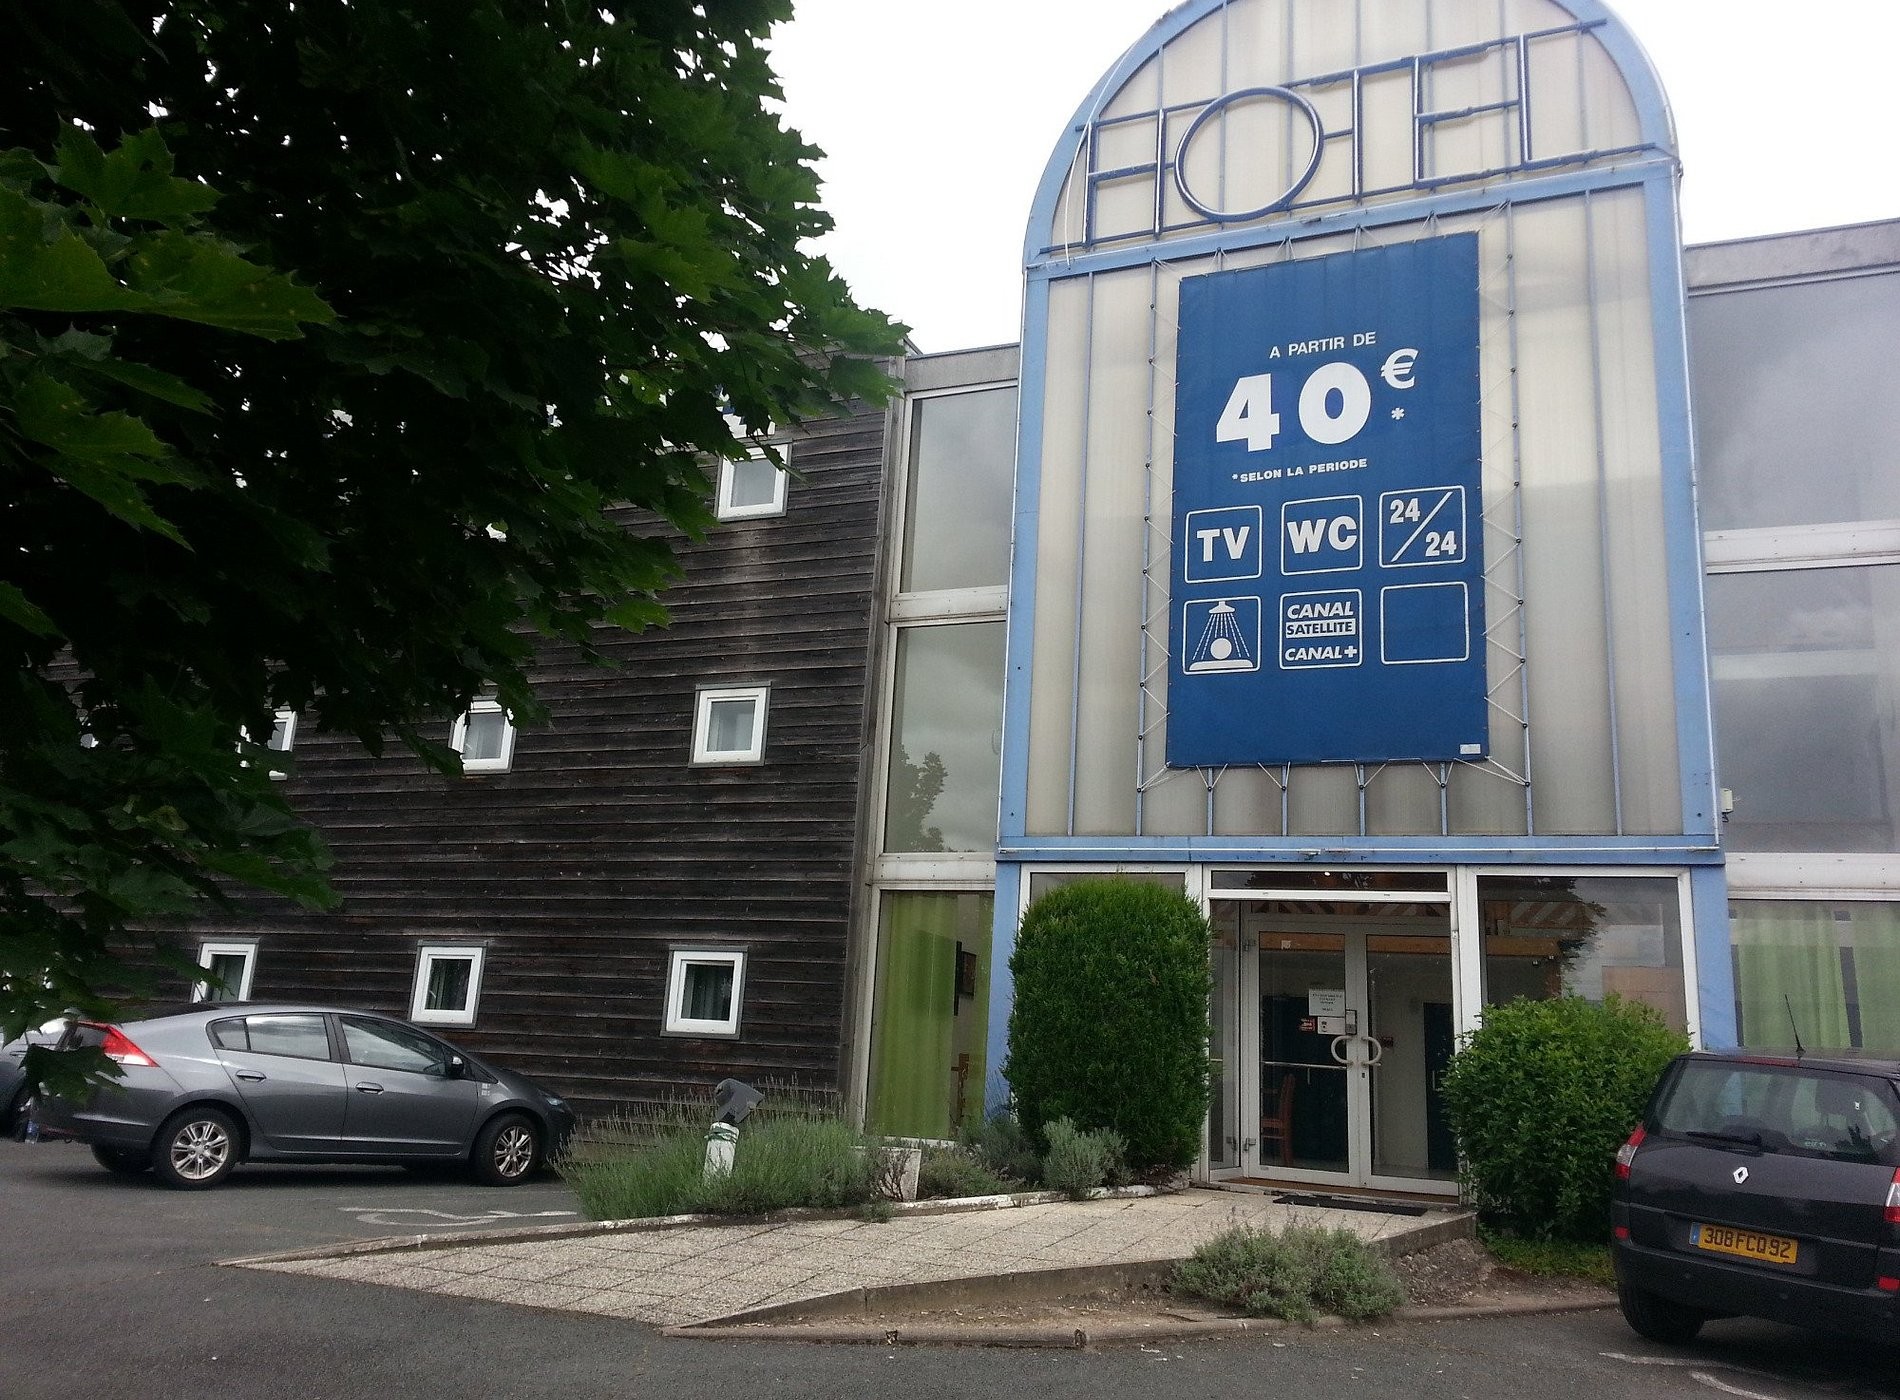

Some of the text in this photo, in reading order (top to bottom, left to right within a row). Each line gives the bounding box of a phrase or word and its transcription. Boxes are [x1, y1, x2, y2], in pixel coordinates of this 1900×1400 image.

[1083, 32, 1655, 246] HOTEL
[1269, 331, 1376, 359] A PARTIR DE
[1287, 466, 1304, 476] LA
[1308, 458, 1368, 474] PERIODE
[1197, 526, 1250, 562] TV
[1287, 515, 1358, 554] WC
[1287, 601, 1354, 619] CANAL
[1286, 621, 1353, 635] SATELLITE
